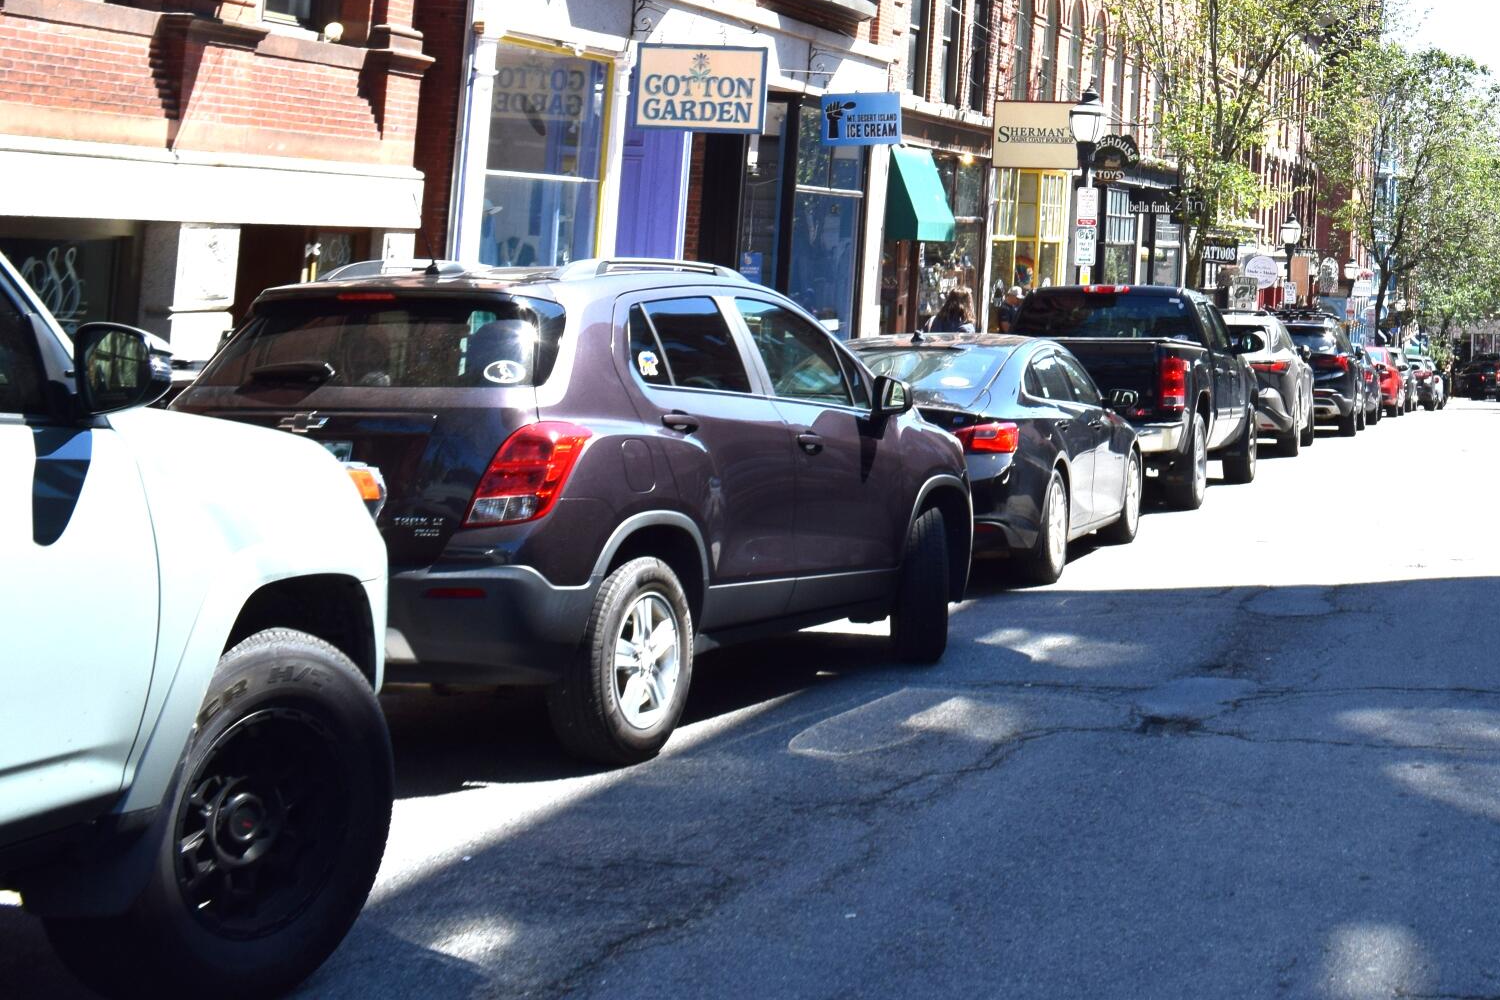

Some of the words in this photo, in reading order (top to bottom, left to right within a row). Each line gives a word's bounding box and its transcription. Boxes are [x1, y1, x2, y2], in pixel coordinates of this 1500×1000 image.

[644, 73, 756, 99] COTTON
[642, 98, 753, 123] GARDEN
[877, 113, 898, 122] ISLAND
[846, 124, 862, 138] ICE
[864, 123, 898, 138] CREAM
[1097, 170, 1120, 180] TOYS
[1129, 201, 1149, 213] bella
